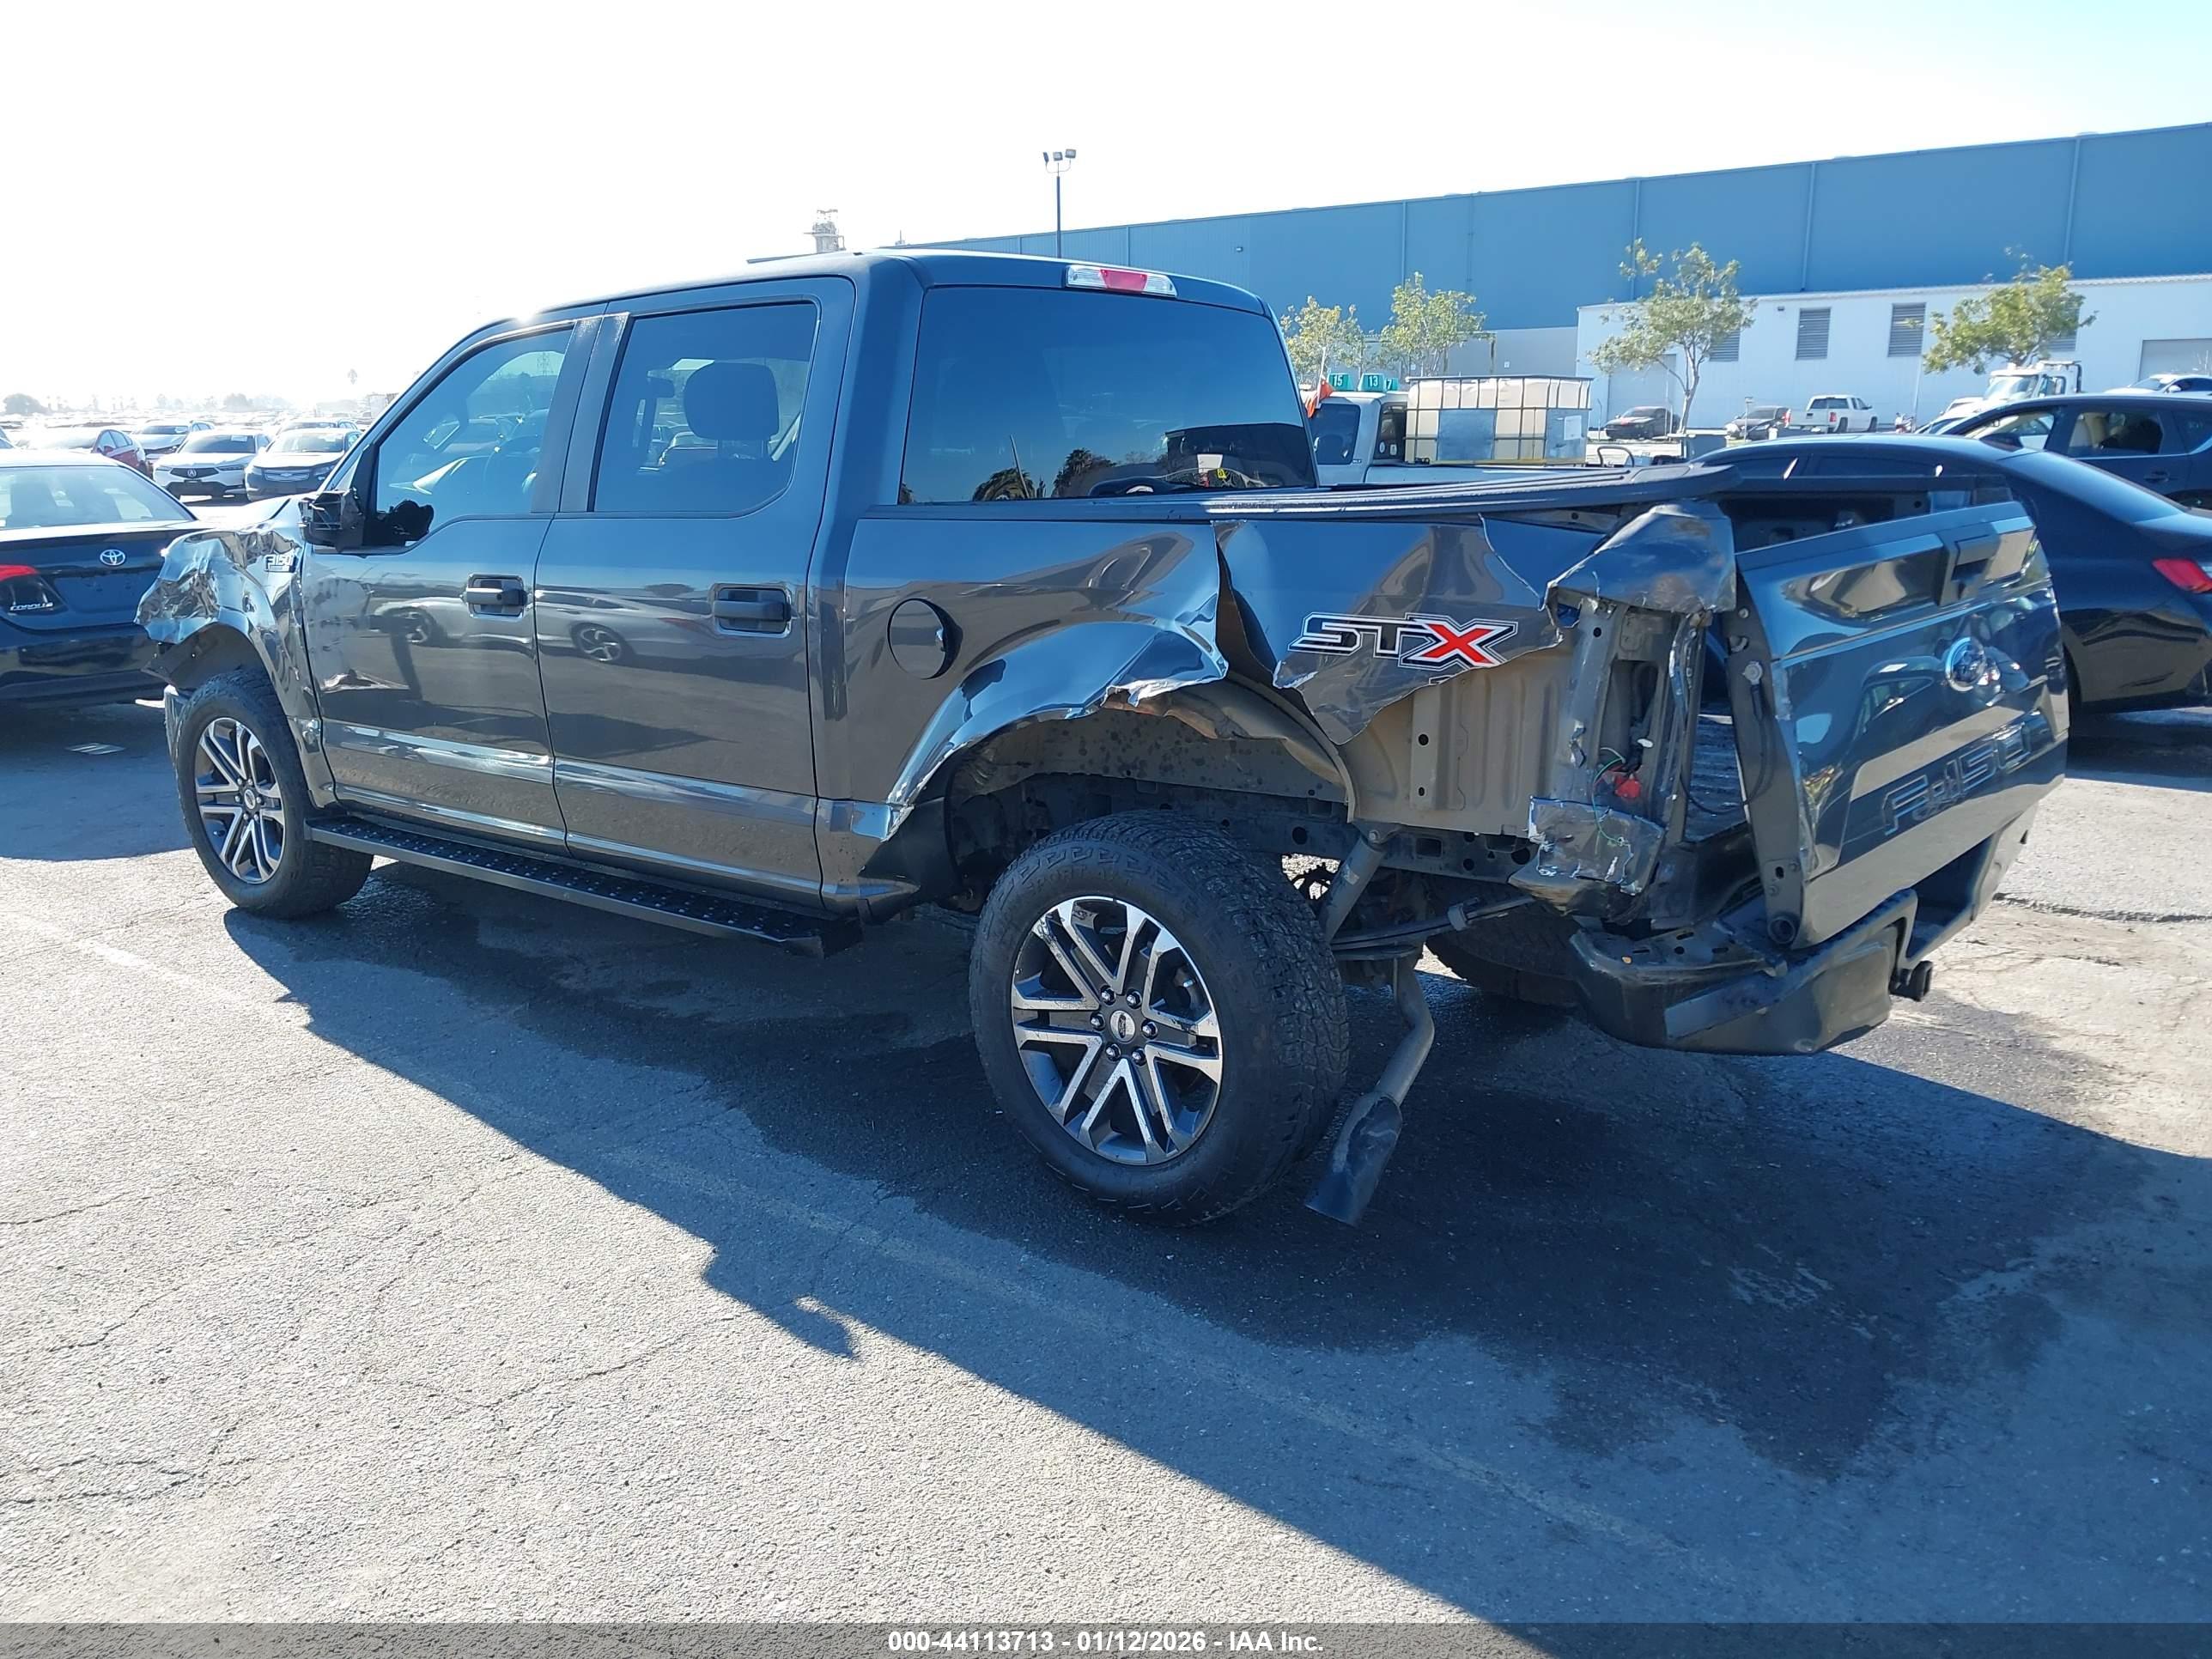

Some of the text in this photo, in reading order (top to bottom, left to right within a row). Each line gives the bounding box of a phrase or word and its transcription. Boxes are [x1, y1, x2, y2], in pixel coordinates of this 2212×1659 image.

[1332, 374, 1344, 387] 15
[1368, 374, 1379, 387] 13
[1288, 612, 1519, 672] STX
